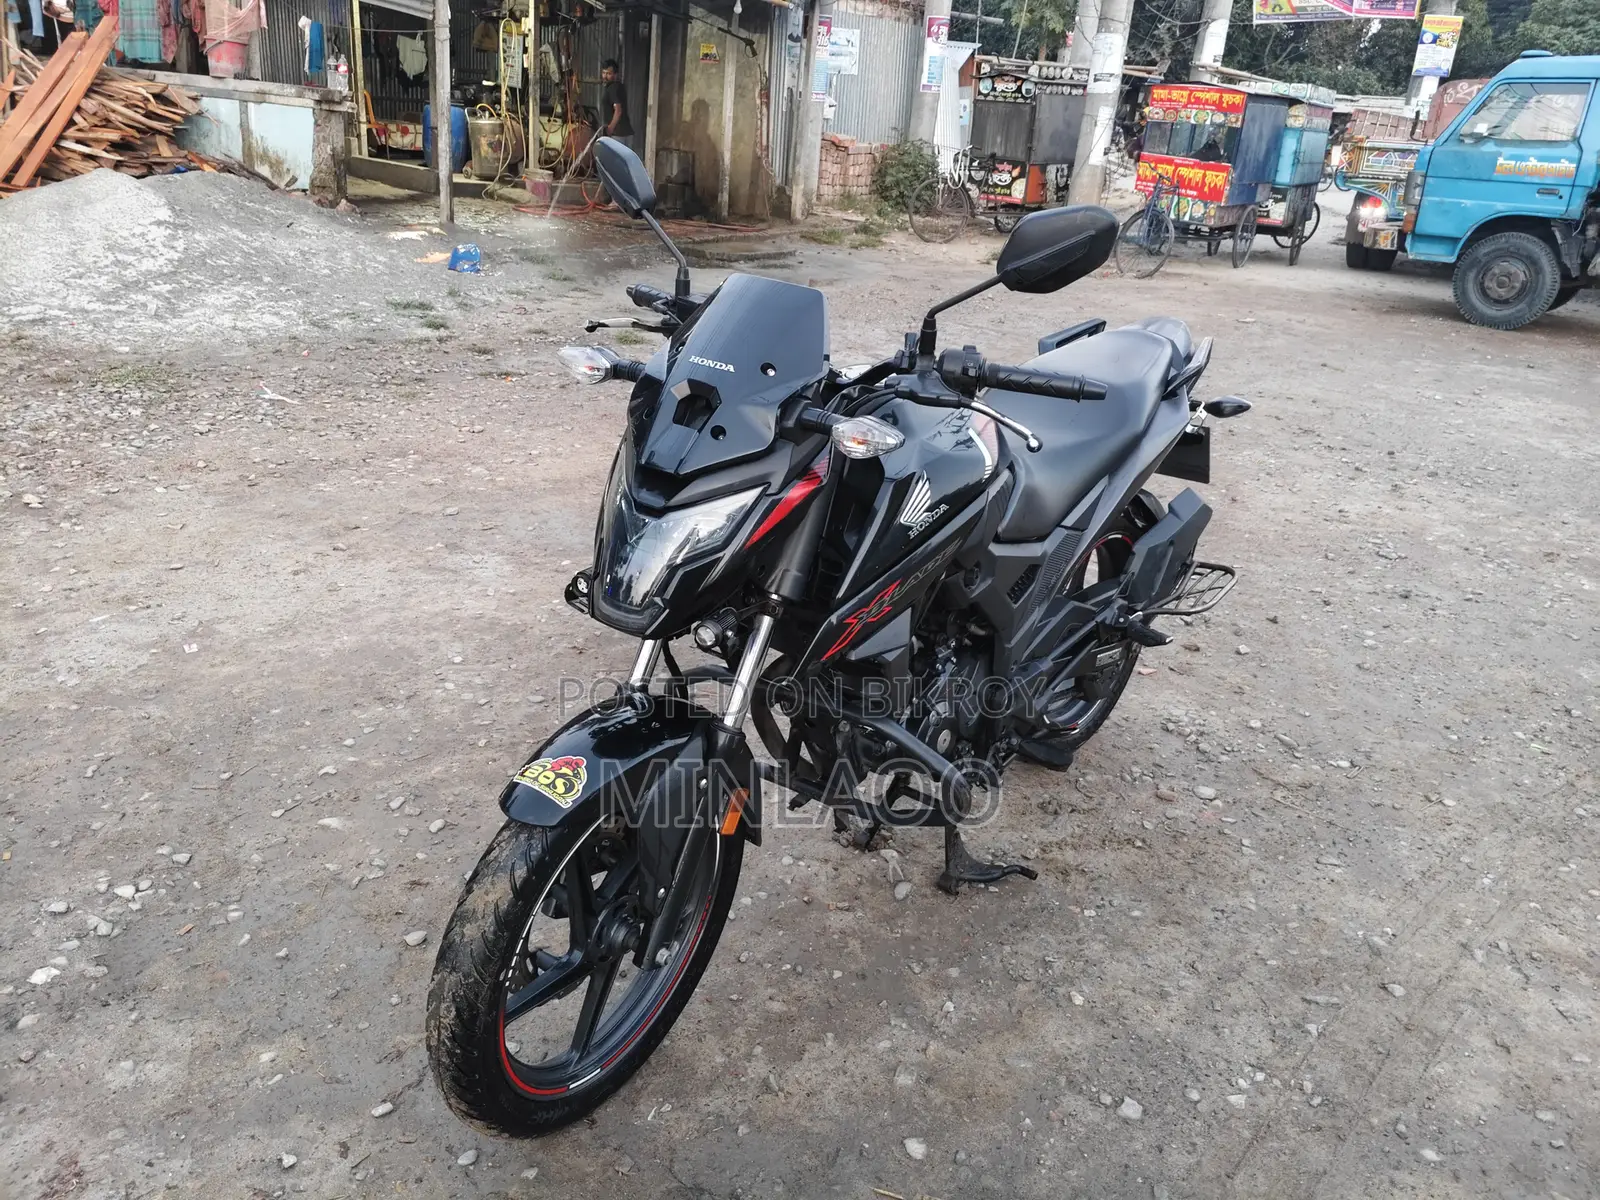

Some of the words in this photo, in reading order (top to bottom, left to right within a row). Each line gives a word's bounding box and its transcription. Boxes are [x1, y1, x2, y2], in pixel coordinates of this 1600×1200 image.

[1152, 88, 1190, 105] মামা-ভাগ্নে
[1191, 90, 1221, 104] স্পেশাল
[1222, 93, 1245, 108] ফুচকা
[1175, 166, 1205, 188] স্পেশাল
[1204, 169, 1227, 194] ফুচকা
[688, 355, 736, 373] HONDA
[907, 503, 950, 540] HONDA
[523, 765, 566, 795] BOS
